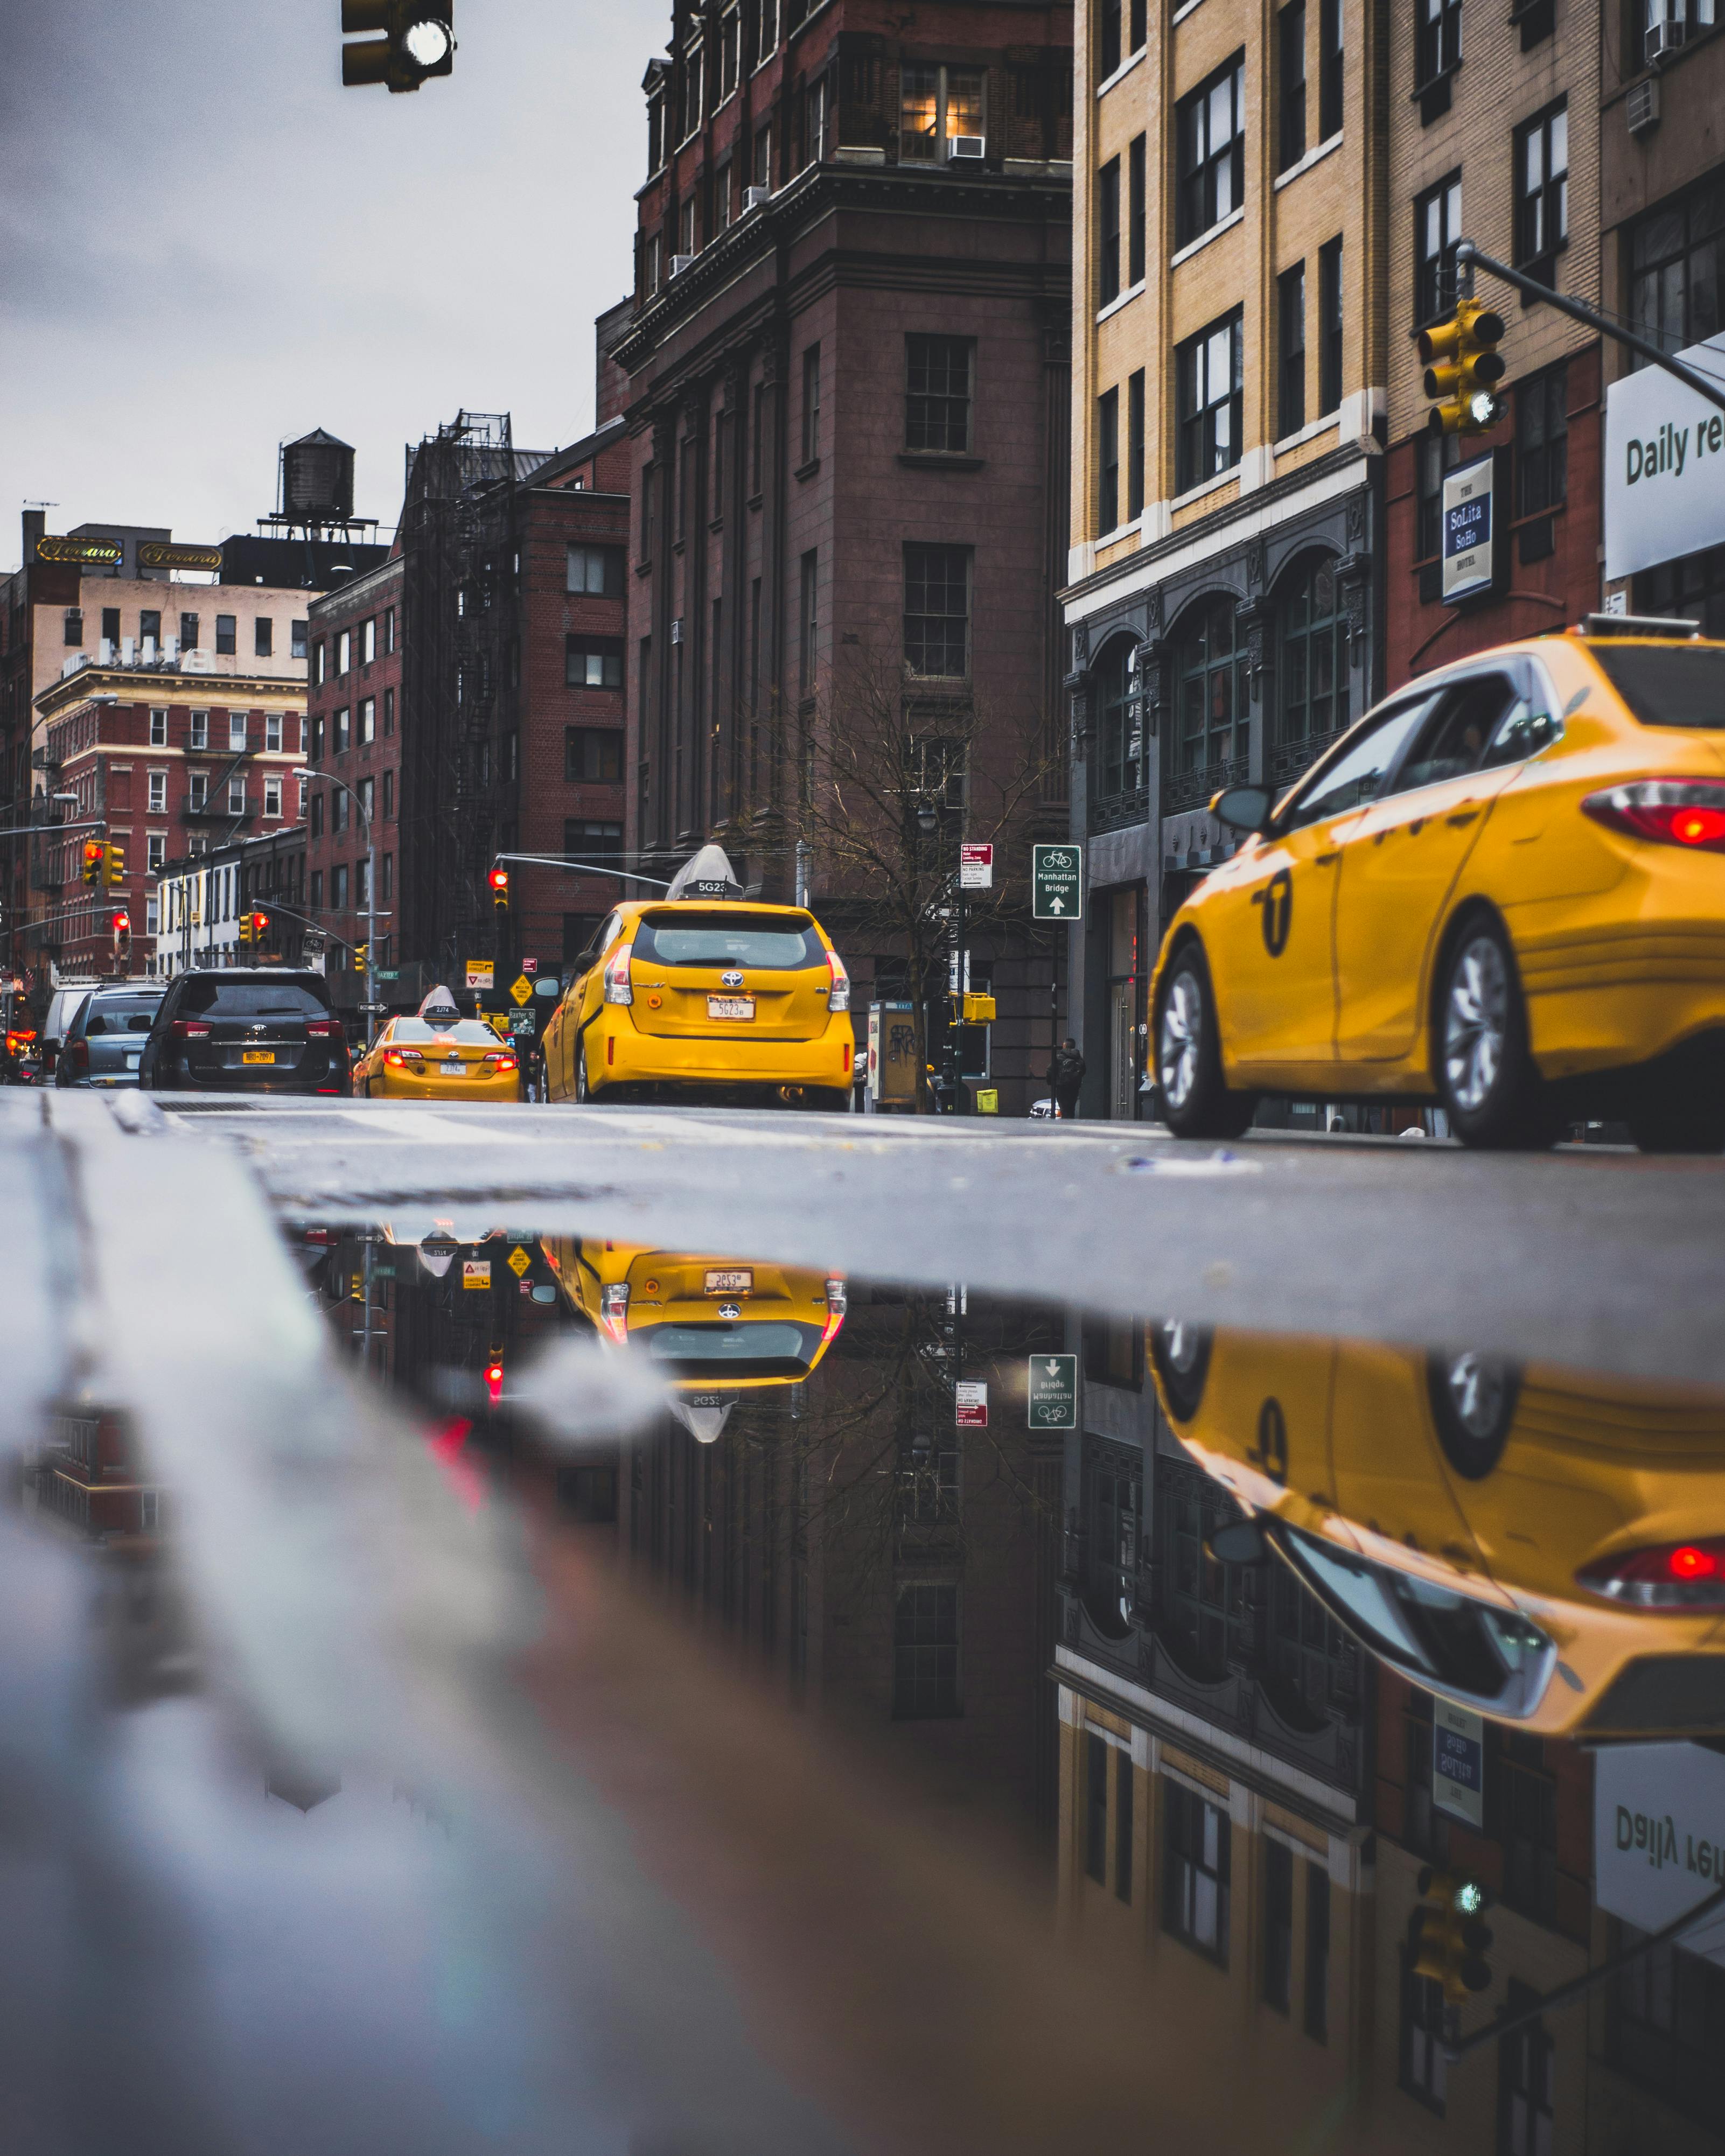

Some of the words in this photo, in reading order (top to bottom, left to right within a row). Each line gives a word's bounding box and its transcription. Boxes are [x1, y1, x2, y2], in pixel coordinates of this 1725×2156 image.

[1627, 422, 1689, 486] Daily
[1698, 414, 1725, 458] re
[1461, 484, 1473, 498] THE
[1451, 505, 1482, 531] SoLita
[1456, 530, 1476, 549] SoHo
[1457, 555, 1476, 571] HOTEL
[699, 883, 727, 892] 5G23
[1045, 884, 1069, 894] Bridge
